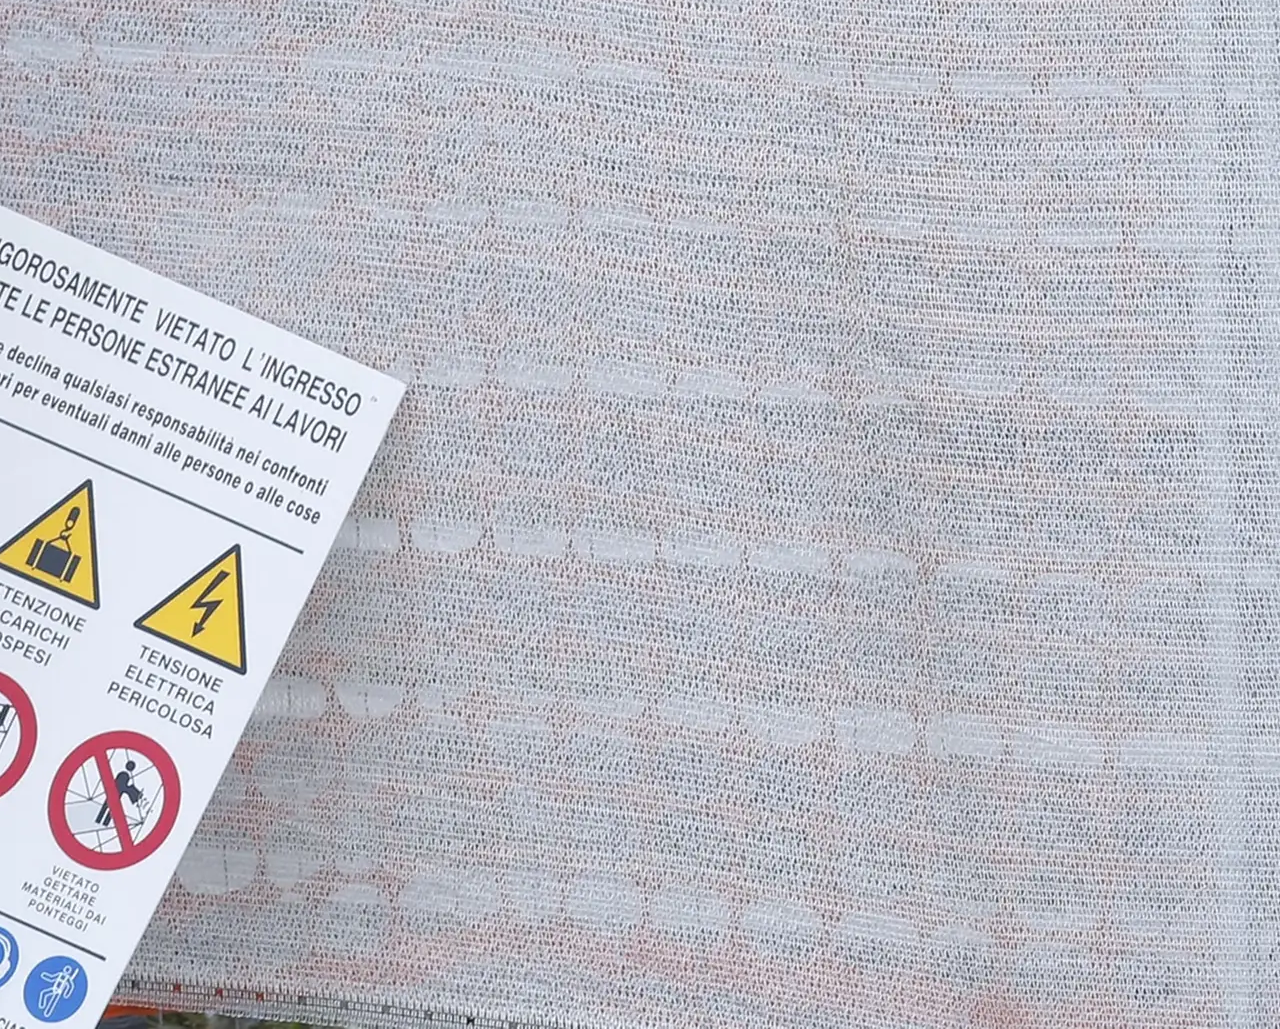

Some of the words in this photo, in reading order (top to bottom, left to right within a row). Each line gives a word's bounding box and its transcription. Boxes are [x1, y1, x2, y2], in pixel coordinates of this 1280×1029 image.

[21, 294, 50, 323] LE
[50, 307, 145, 364] PERSONE
[145, 348, 250, 410] ESTRANEE
[248, 395, 273, 420] AI
[272, 403, 347, 452] LAVORI
[156, 308, 236, 361] VIETATO
[242, 348, 361, 416] L'INGRESSO
[7, 346, 60, 379] declina
[63, 373, 131, 409] qualsiasi
[131, 402, 233, 455] responsabilità
[236, 447, 261, 466] nei
[262, 459, 329, 496] confronti
[12, 381, 39, 400] per
[42, 393, 110, 431] eventuali
[111, 421, 153, 449] danni
[154, 442, 181, 462] alle
[182, 455, 241, 488] persone
[244, 482, 253, 494] o
[256, 487, 283, 507] alle
[287, 500, 320, 524] cose
[0, 610, 70, 650] CARICHI
[125, 664, 214, 715] ELETTRICA
[140, 645, 223, 693] TENSIONE
[107, 681, 212, 739] PERICOLOSA
[22, 882, 83, 914] MATERIALI
[85, 910, 106, 925] DAI
[44, 877, 96, 906] GETTARE
[53, 866, 99, 893] VIETATO
[28, 899, 88, 931] PONTEGGI
